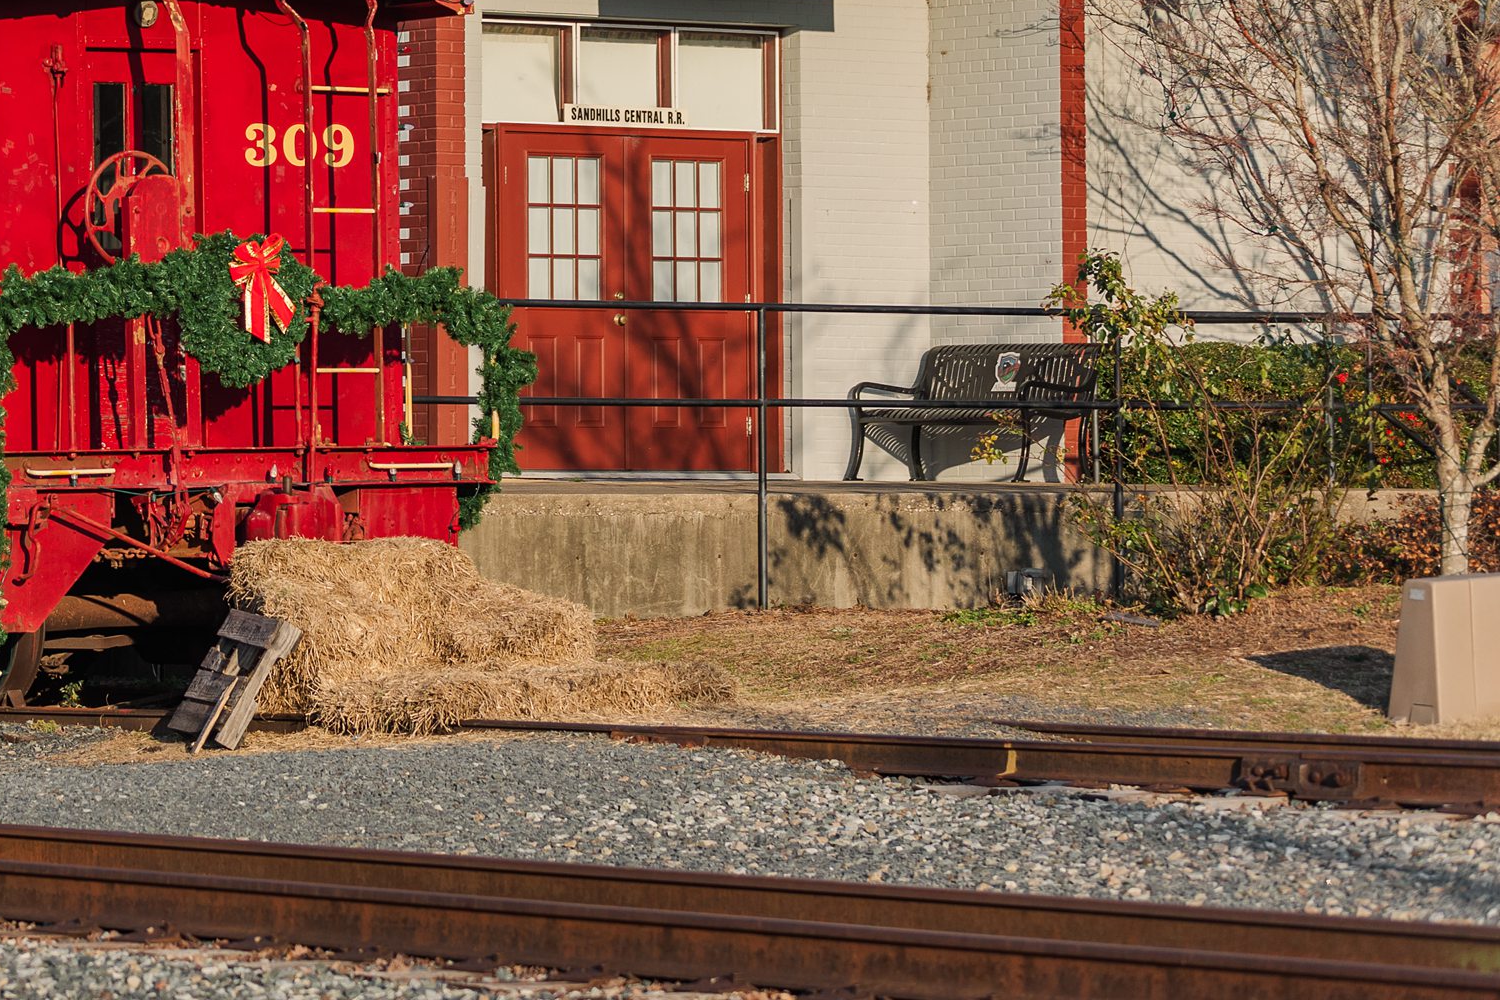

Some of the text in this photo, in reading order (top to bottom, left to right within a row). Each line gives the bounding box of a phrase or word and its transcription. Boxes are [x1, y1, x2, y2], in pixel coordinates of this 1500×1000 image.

[571, 107, 685, 125] SANDHILLS CENTRAL R.R.
[244, 122, 355, 168] 309
